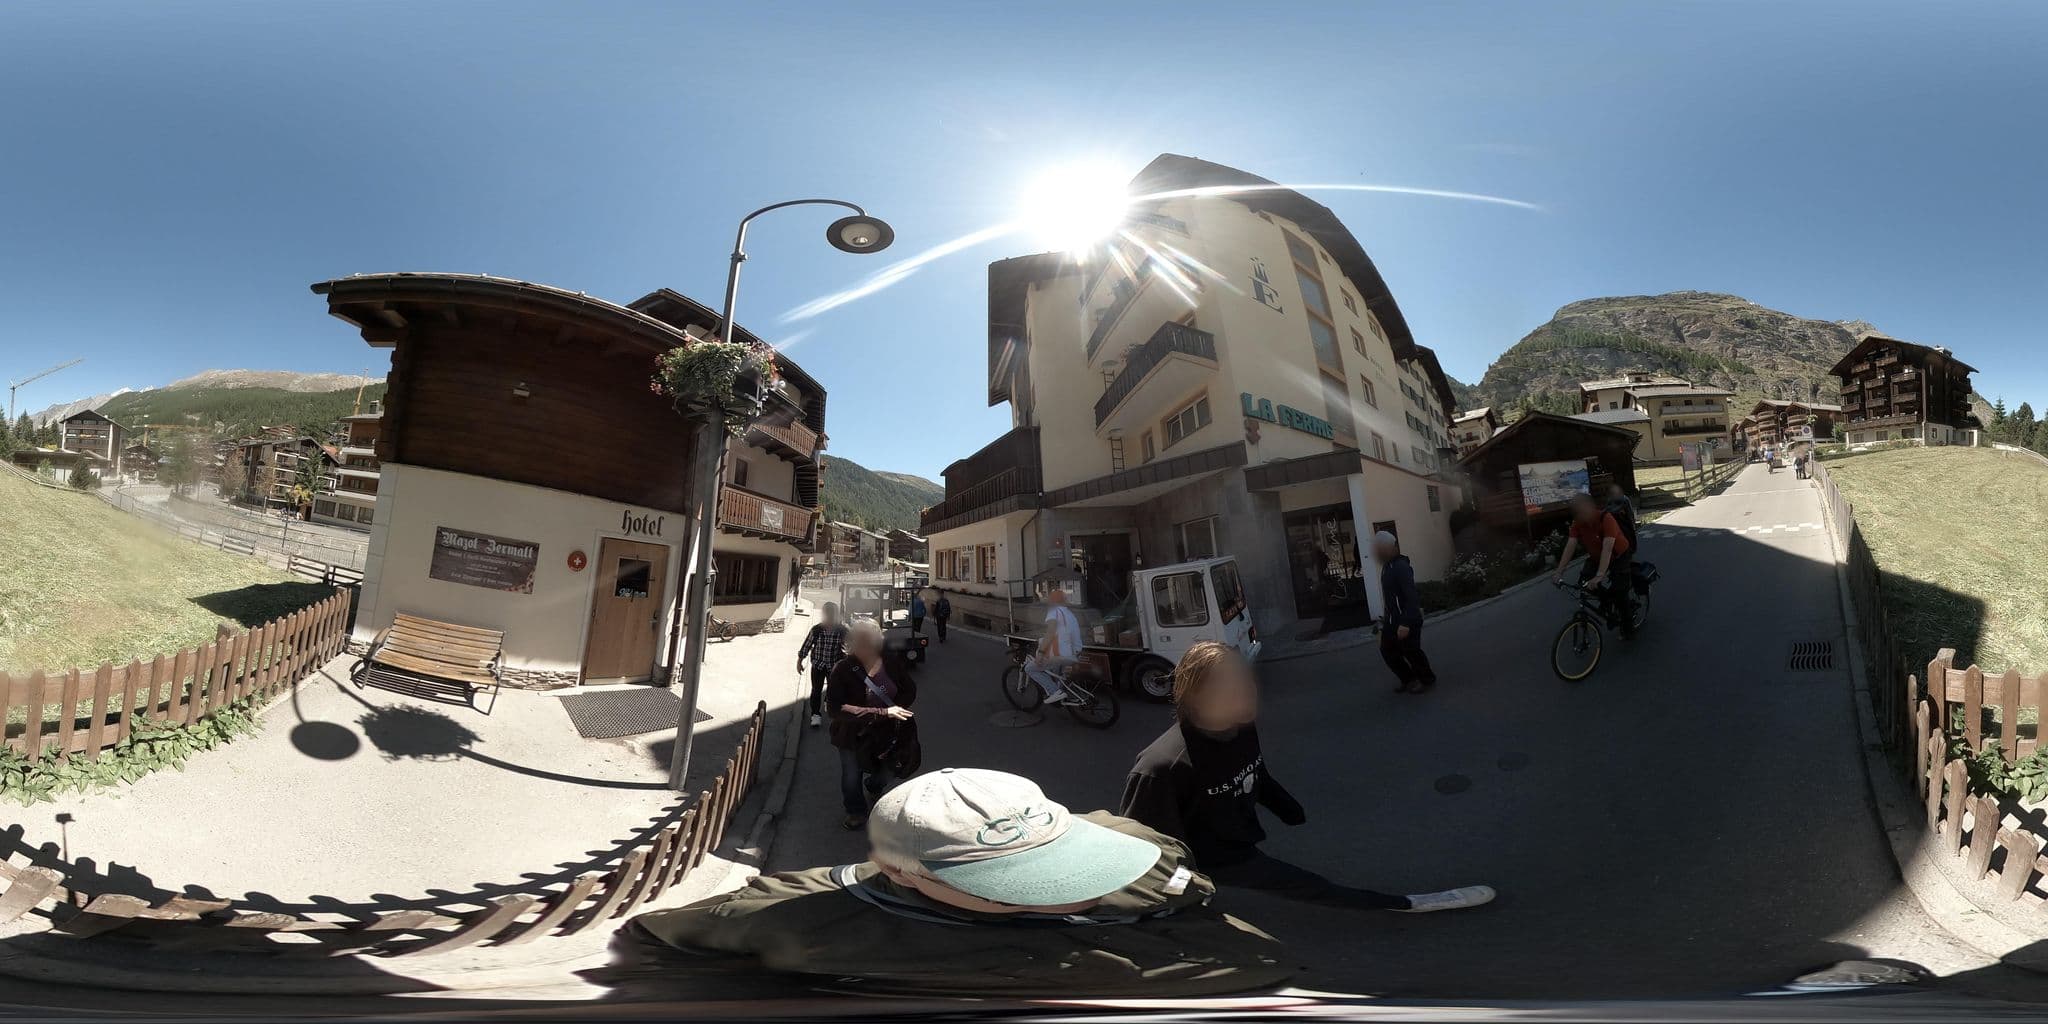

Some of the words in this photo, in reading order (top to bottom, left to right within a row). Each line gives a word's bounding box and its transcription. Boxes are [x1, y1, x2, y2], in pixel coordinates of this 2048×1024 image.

[1240, 392, 1275, 422] LA
[1277, 404, 1335, 440] FERME
[441, 531, 479, 550] Mazot
[1207, 783, 1233, 795] U.S.
[1233, 763, 1254, 785] POLO
